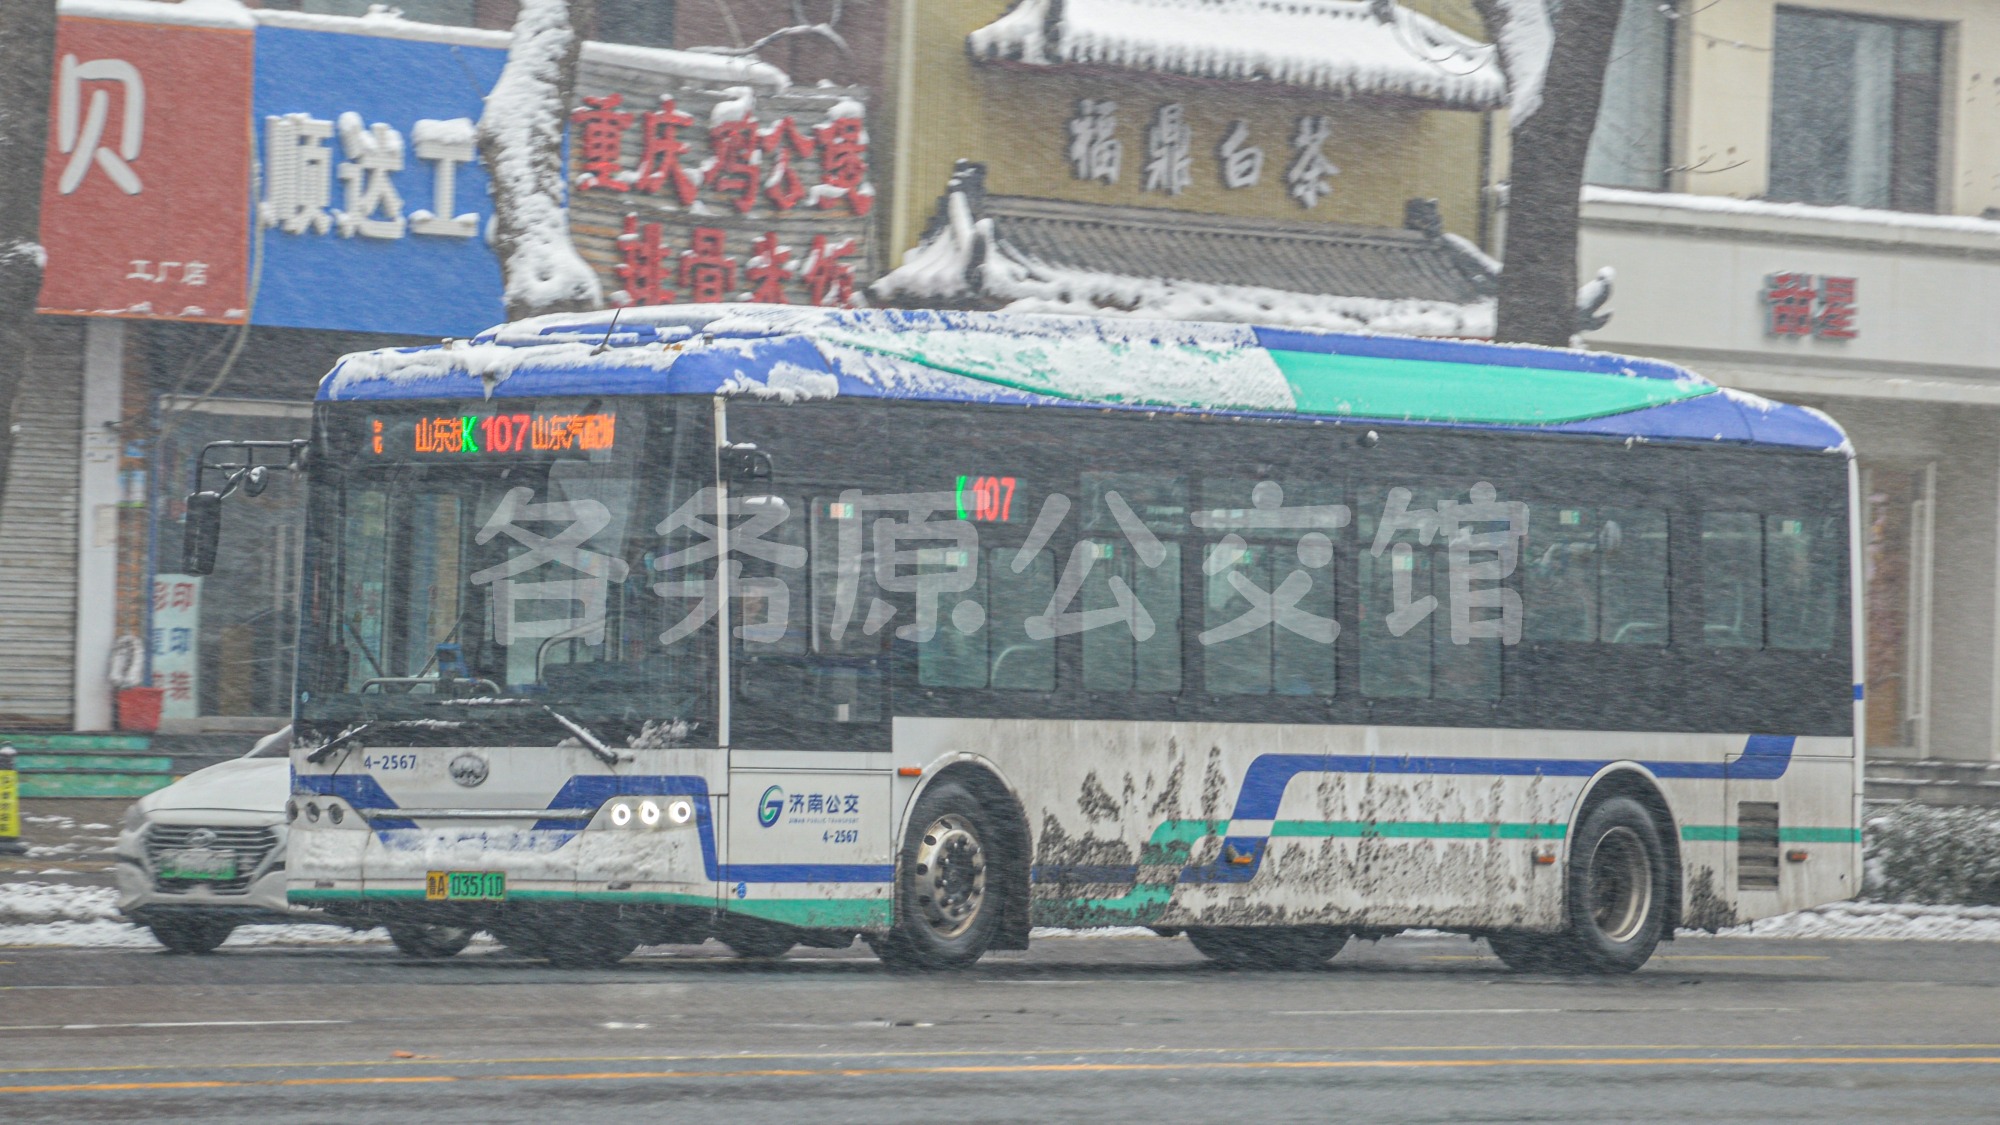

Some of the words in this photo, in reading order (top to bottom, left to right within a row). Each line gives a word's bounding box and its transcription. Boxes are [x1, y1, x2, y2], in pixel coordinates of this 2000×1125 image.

[570, 92, 875, 216] 重庆鸡公煲
[1067, 98, 1341, 209] 福鼎白茶
[262, 111, 497, 240] 顺达工
[126, 259, 210, 286] 工厂店
[363, 754, 417, 770] 4-2567
[788, 793, 860, 814] 济南公交
[822, 829, 859, 844] 4-2567
